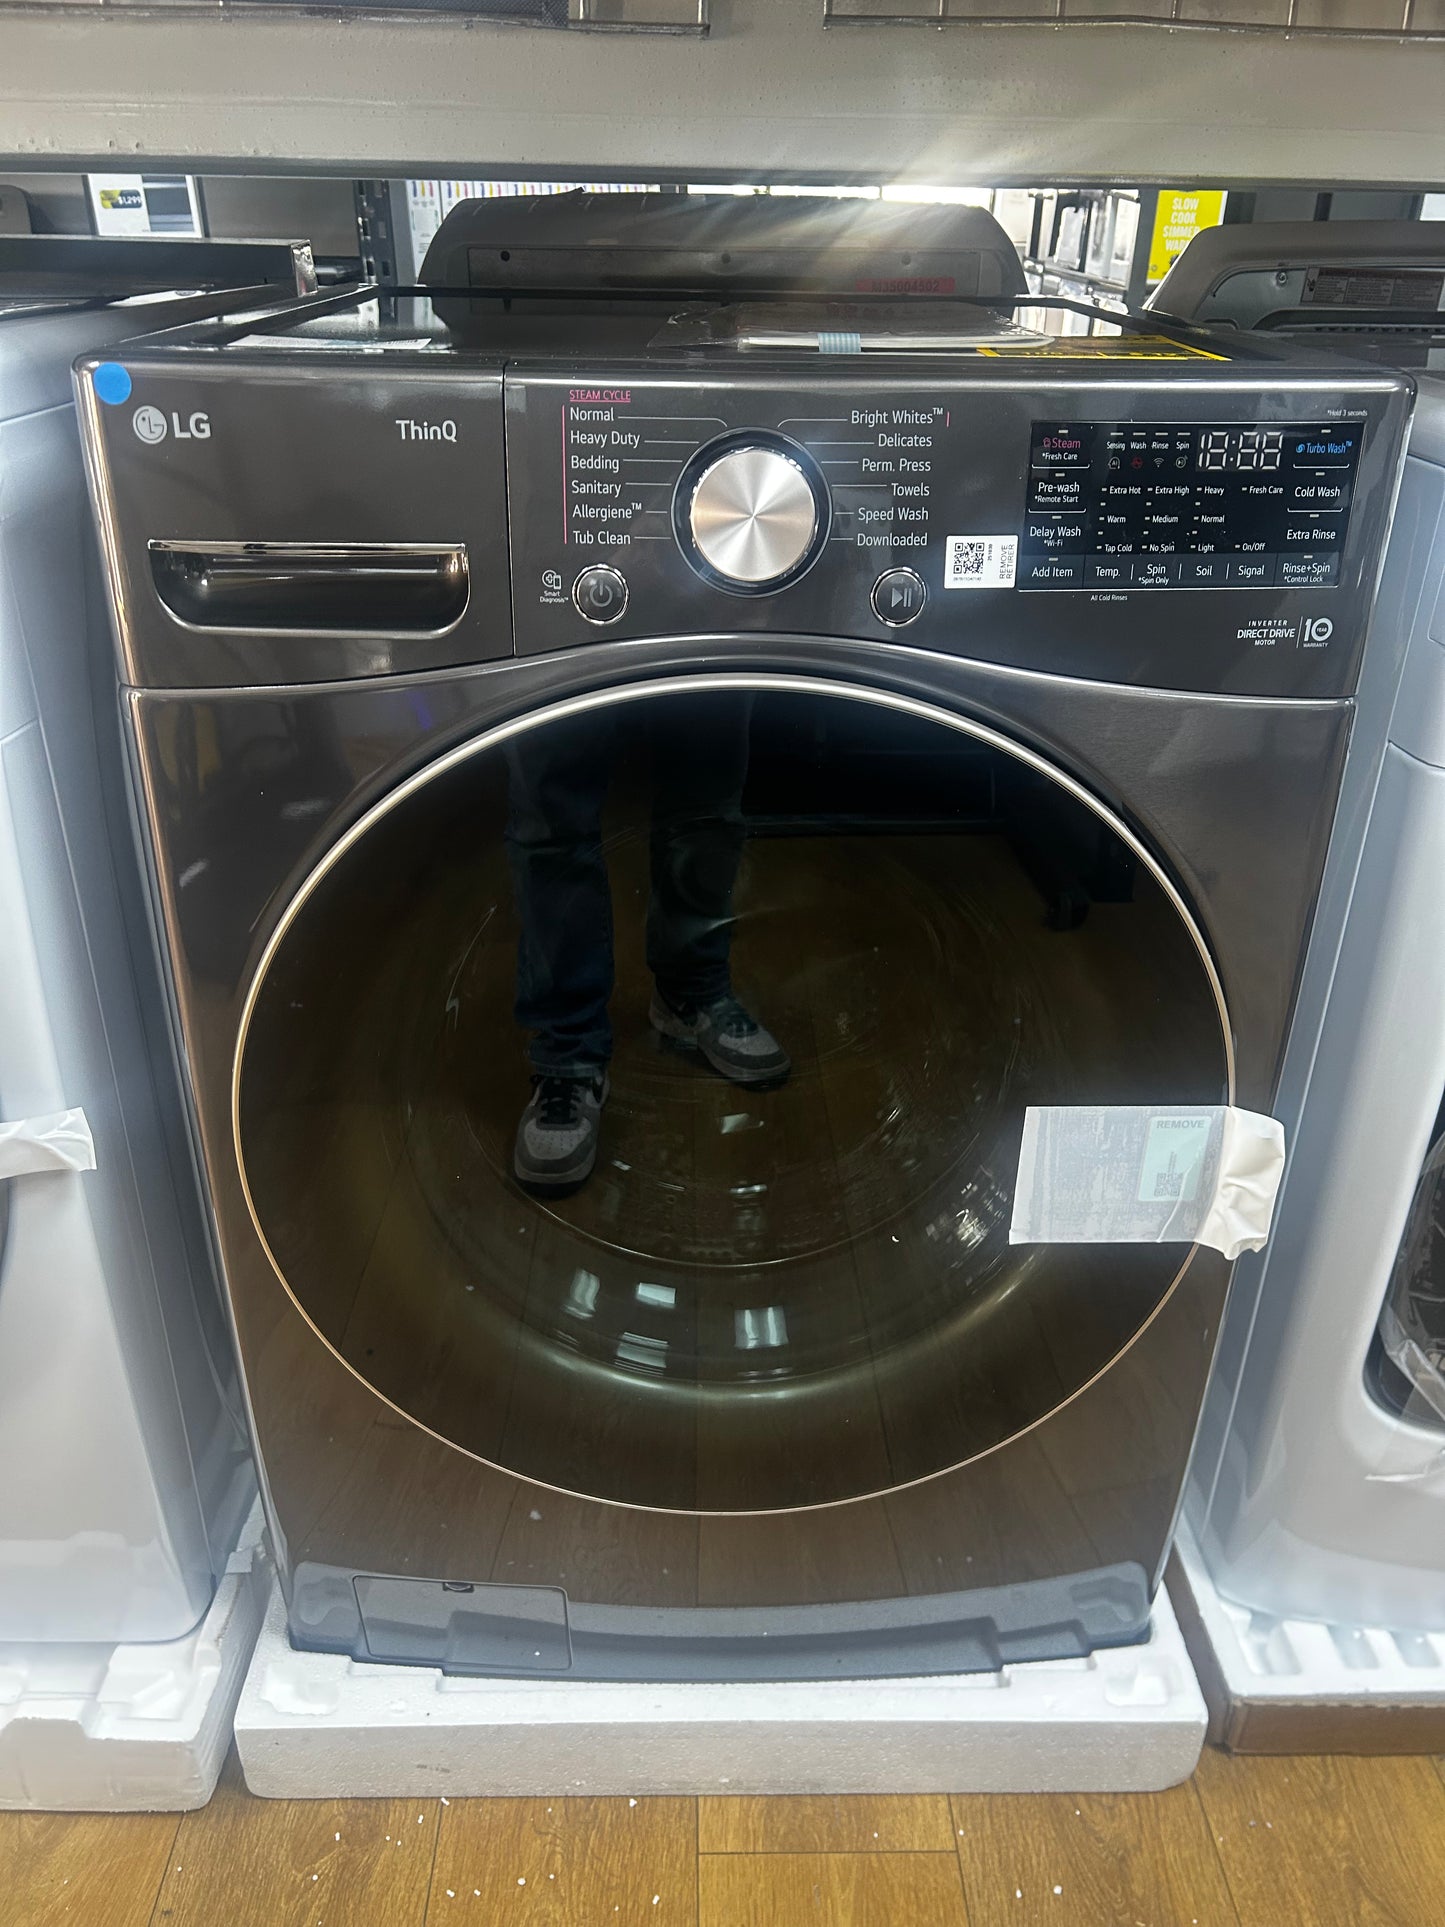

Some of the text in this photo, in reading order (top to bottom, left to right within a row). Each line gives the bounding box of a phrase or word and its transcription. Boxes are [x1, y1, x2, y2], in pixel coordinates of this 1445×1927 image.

[1172, 198, 1199, 210] SLOW
[1171, 212, 1196, 224] COOK
[570, 390, 631, 400] STEAM CYCLE
[570, 407, 614, 421] Normal
[851, 410, 888, 427] Bright
[173, 413, 211, 438] LG
[396, 420, 457, 442] ThinQ
[570, 431, 640, 448] Heavy Duty
[879, 433, 932, 447] Delicates
[1052, 439, 1080, 448] Steam
[1107, 442, 1125, 451] Sensing
[1176, 442, 1189, 450] Spin
[1306, 443, 1325, 453] Turbo
[571, 456, 619, 473] Bedding
[862, 458, 931, 472] Perm. Press
[572, 480, 621, 498] Sanitary
[891, 482, 930, 496] Towels
[1038, 482, 1080, 493] Pre-wash
[1110, 486, 1141, 494] Extra Hot
[1155, 486, 1189, 496] Extra High
[1205, 486, 1224, 496] Heavy
[1250, 486, 1283, 494] Fresh Care
[1295, 486, 1340, 497] Cold Wash
[1063, 495, 1078, 503] Start
[858, 507, 928, 524] Speed Wash
[1153, 515, 1178, 523] Medium
[1201, 515, 1225, 523] Normal
[573, 531, 630, 544] Tub Clean
[1030, 526, 1081, 539] Delay Wash
[1287, 529, 1336, 540] Extra Rinse
[857, 533, 927, 546] Downloaded
[1105, 544, 1116, 553] Tap
[1161, 544, 1175, 553] Spin
[1198, 544, 1214, 553] Light
[1242, 543, 1266, 551] On/Off
[999, 545, 1007, 579] REMOVE
[1006, 544, 1015, 579] RETIRER
[1032, 567, 1073, 577] Add Item
[1096, 567, 1120, 577] Temp.
[1147, 564, 1166, 576] Spin
[1196, 565, 1213, 576] Soil
[1238, 565, 1264, 578] Signal
[1283, 563, 1330, 575] Rinse+Spin
[1156, 577, 1169, 585] Only
[1237, 629, 1295, 639] DIRECT DRIVE
[1304, 618, 1333, 642] 10
[1156, 1120, 1205, 1129] REMOVE
